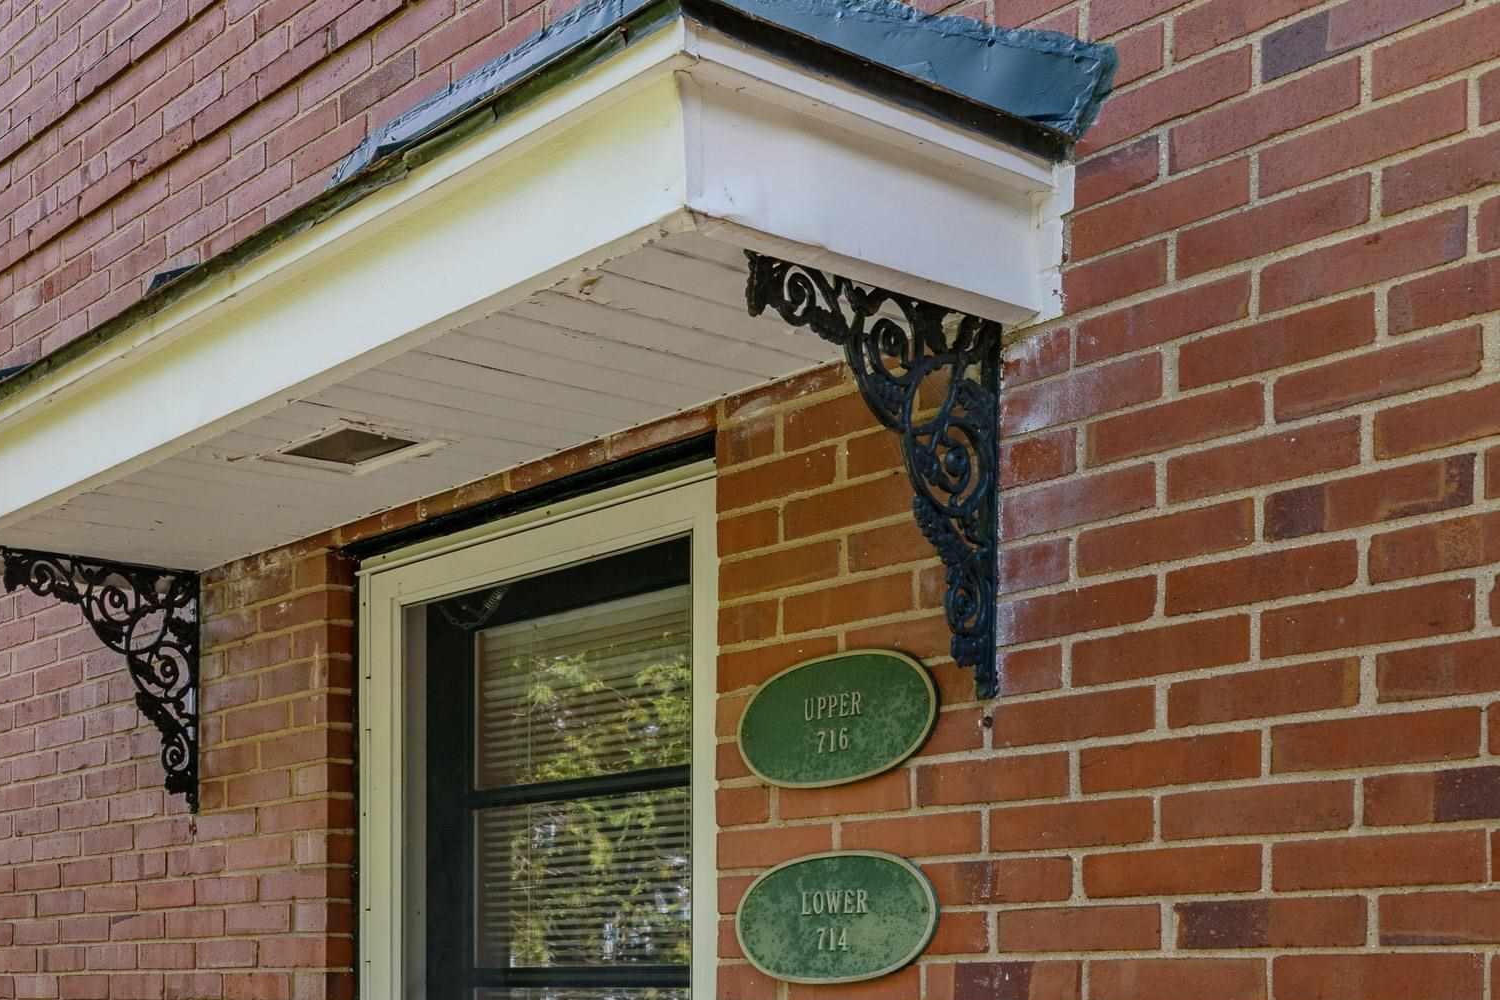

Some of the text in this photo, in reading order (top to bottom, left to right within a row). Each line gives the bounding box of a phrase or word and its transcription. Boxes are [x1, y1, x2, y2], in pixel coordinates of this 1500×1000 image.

[804, 691, 861, 721] UPPER
[817, 727, 849, 753] 716
[801, 889, 868, 916] LOWER
[816, 928, 848, 951] 714
